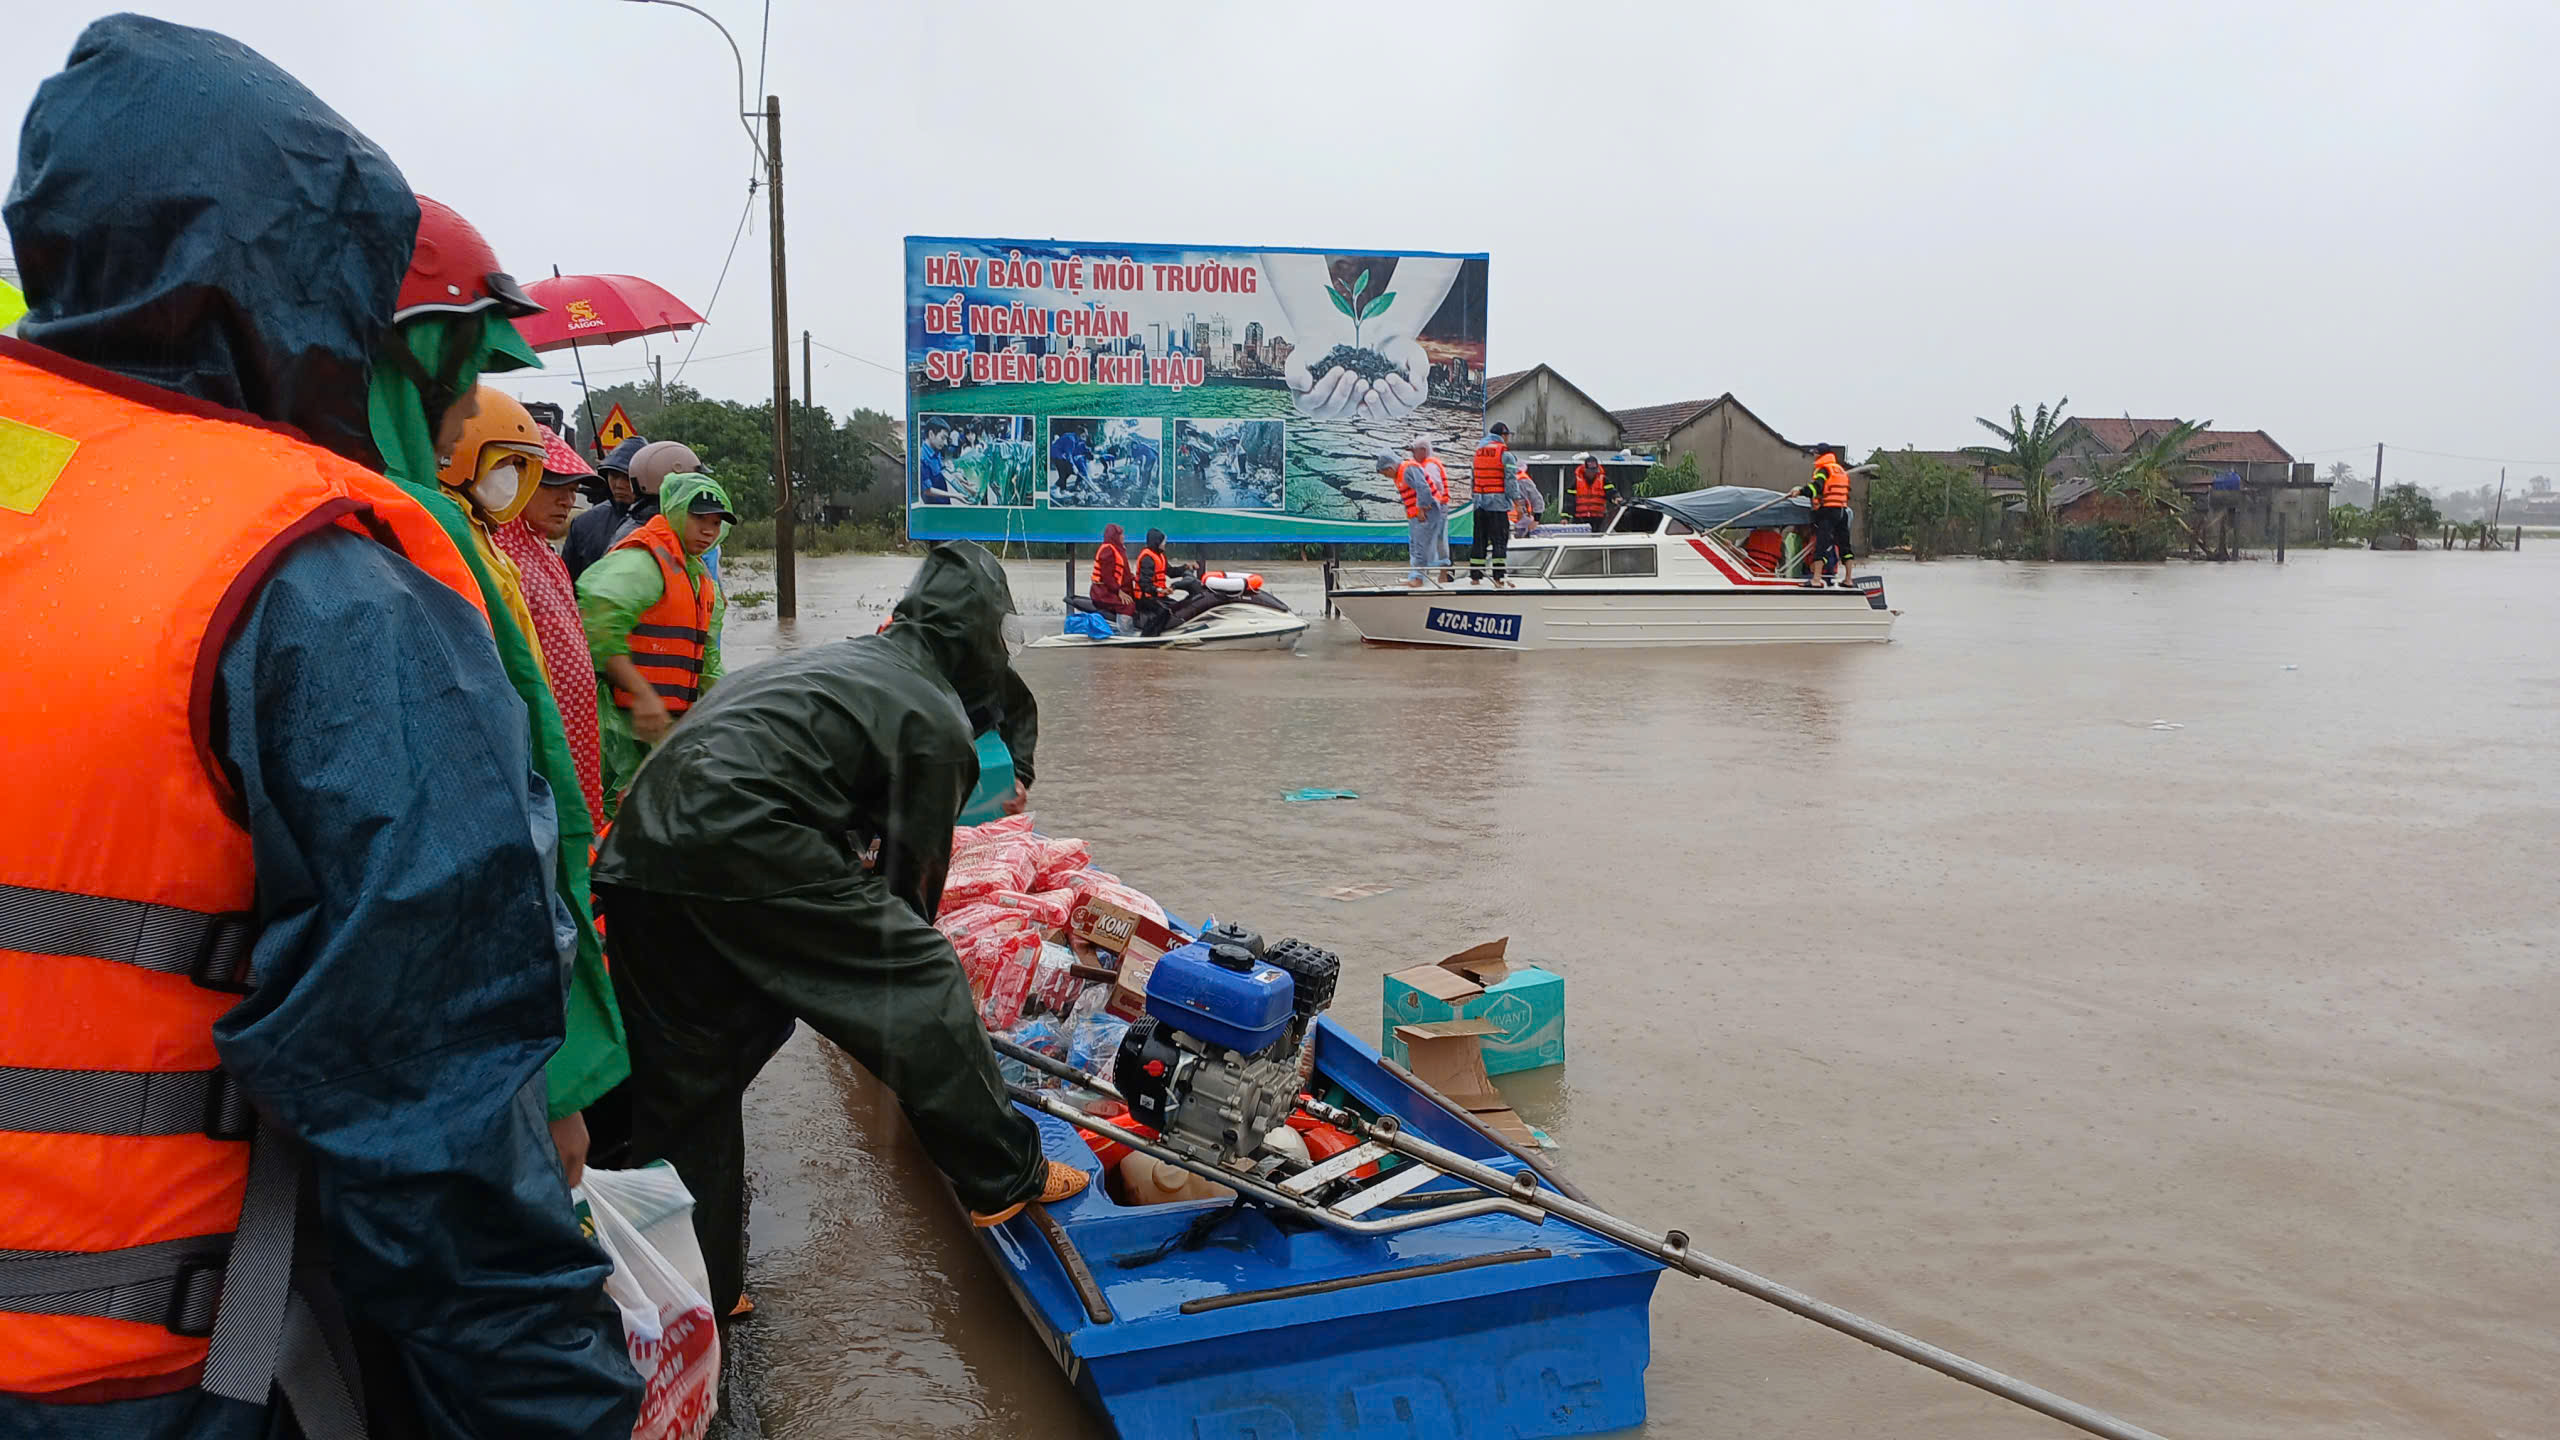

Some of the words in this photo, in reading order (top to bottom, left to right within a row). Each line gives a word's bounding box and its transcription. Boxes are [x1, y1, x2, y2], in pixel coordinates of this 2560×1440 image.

[926, 252, 979, 286] HÃY
[987, 251, 1042, 288] BẢO
[1051, 257, 1083, 295] VỆ
[1093, 258, 1144, 291] MÔI
[1152, 259, 1256, 293] TRƯỜNG
[567, 319, 604, 330] SAIGON
[926, 295, 963, 333] ĐỂ
[970, 302, 1046, 335] NGĂN
[1056, 304, 1128, 343] CHẶN
[927, 350, 966, 386] SỰ
[972, 346, 1036, 382] BIẾN
[1044, 346, 1089, 383] ĐỔI
[1098, 352, 1143, 384] KHÍ
[1151, 353, 1203, 391] HẬU
[1097, 914, 1131, 939] KOMI
